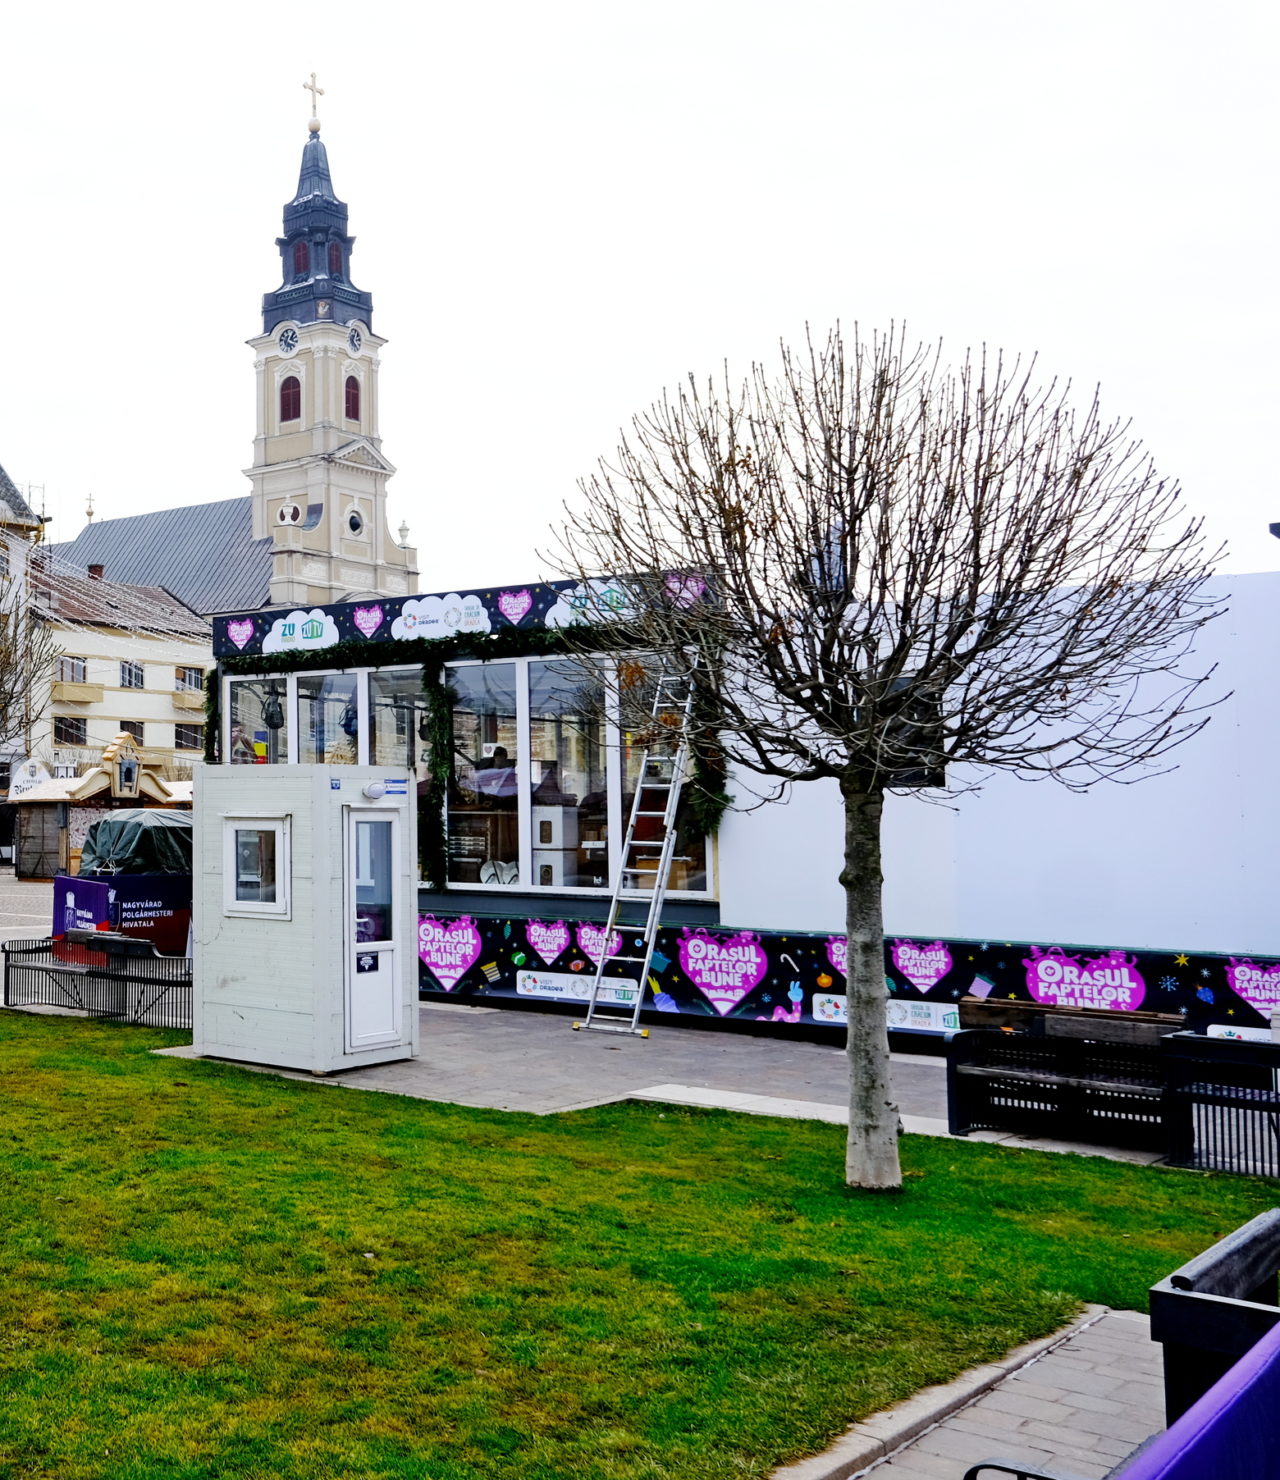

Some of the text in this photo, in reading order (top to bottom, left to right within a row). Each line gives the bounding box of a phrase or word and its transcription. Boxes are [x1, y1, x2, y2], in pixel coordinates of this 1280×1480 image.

[281, 623, 296, 637] ZU
[122, 899, 163, 909] NAGYVÁRAD
[122, 909, 174, 919] POLGÁRMESTERI
[122, 920, 155, 928] HIVATALA
[531, 936, 566, 945] FAPTELOR
[537, 942, 558, 951] BUNE
[420, 941, 473, 955] FAPTELOR
[430, 951, 463, 965] BUNE
[898, 958, 946, 970] FAPTELOR
[688, 958, 757, 976] FAPTELOR
[907, 966, 937, 977] BUNE
[701, 971, 743, 987] BUNE
[1038, 981, 1131, 1003] FAPTELOR
